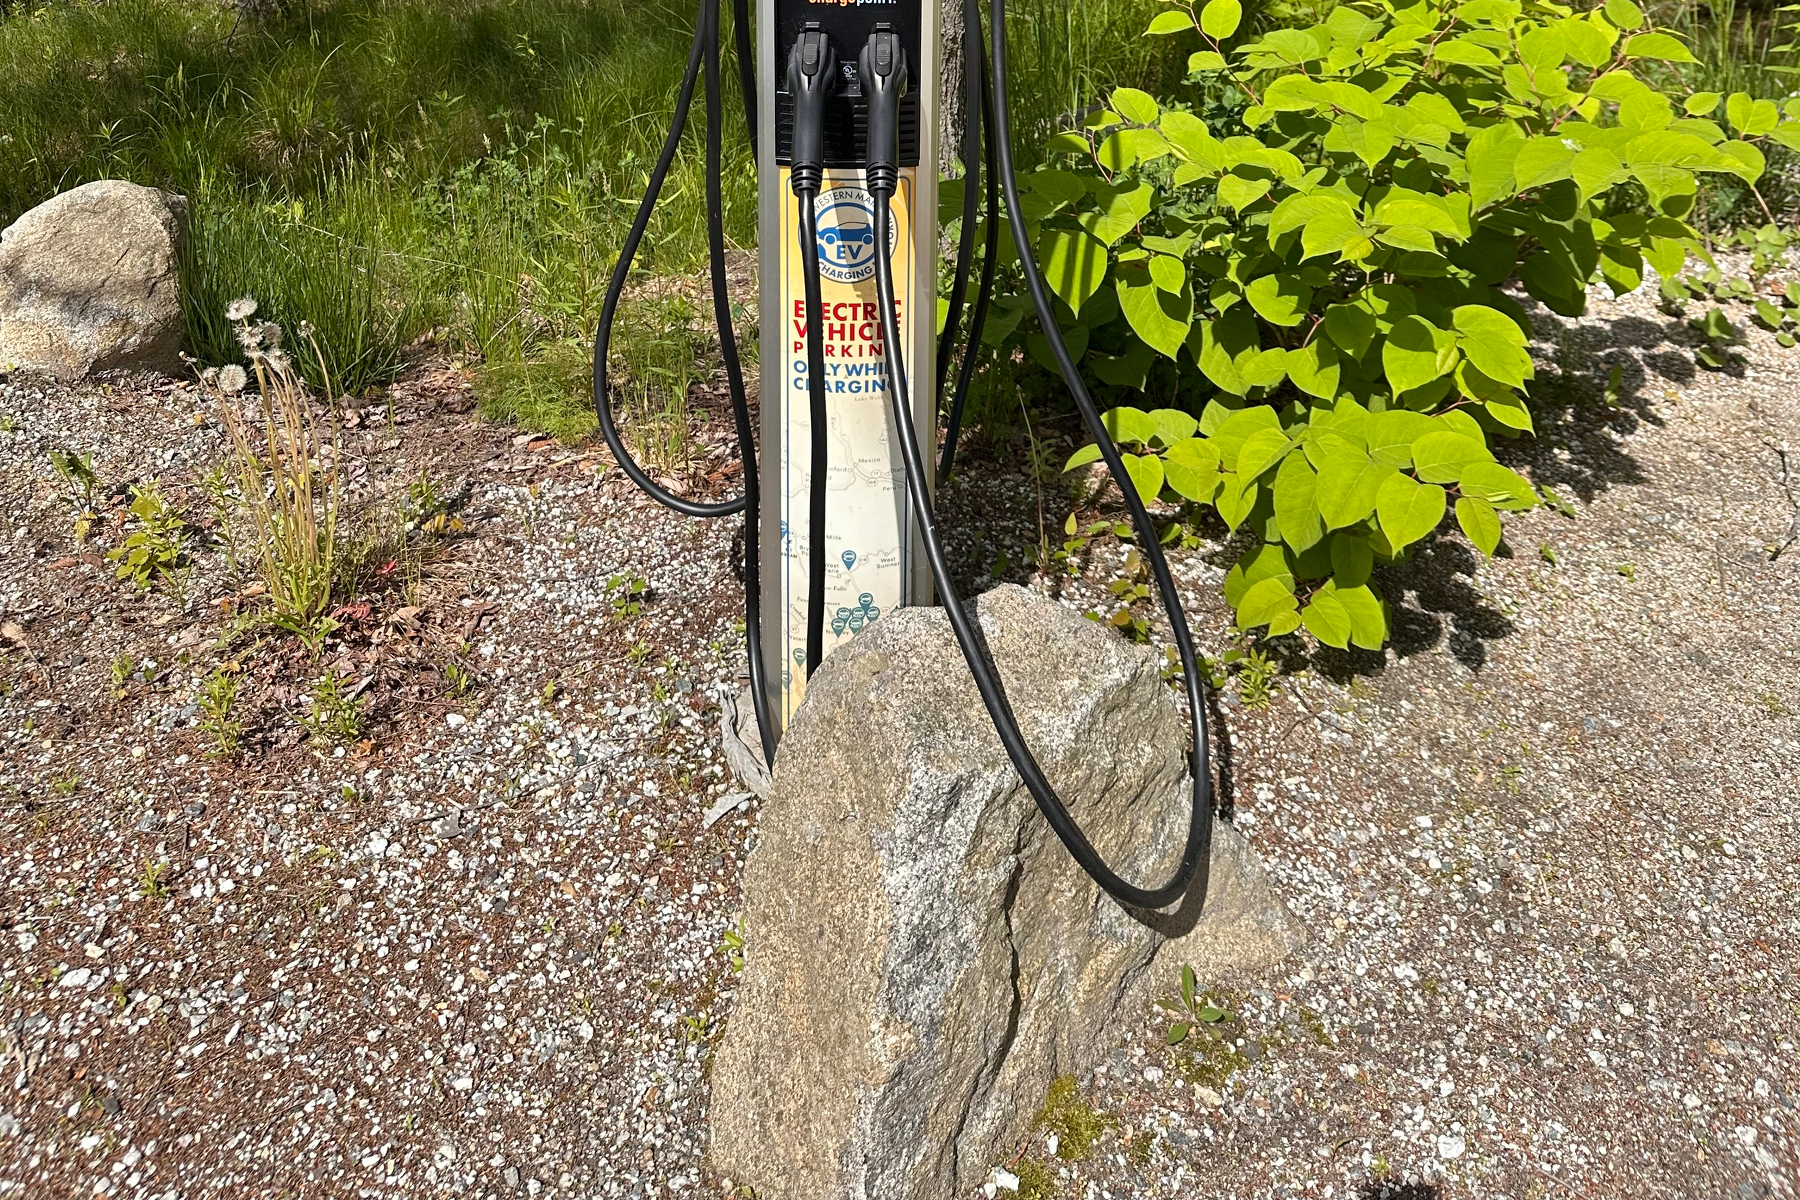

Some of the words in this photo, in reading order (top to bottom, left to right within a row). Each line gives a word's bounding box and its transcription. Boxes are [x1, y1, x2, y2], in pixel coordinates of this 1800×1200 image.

[836, 245, 863, 260] EV
[818, 261, 873, 279] CHARGING
[794, 341, 883, 357] PRKIN
[793, 360, 842, 376] OLY
